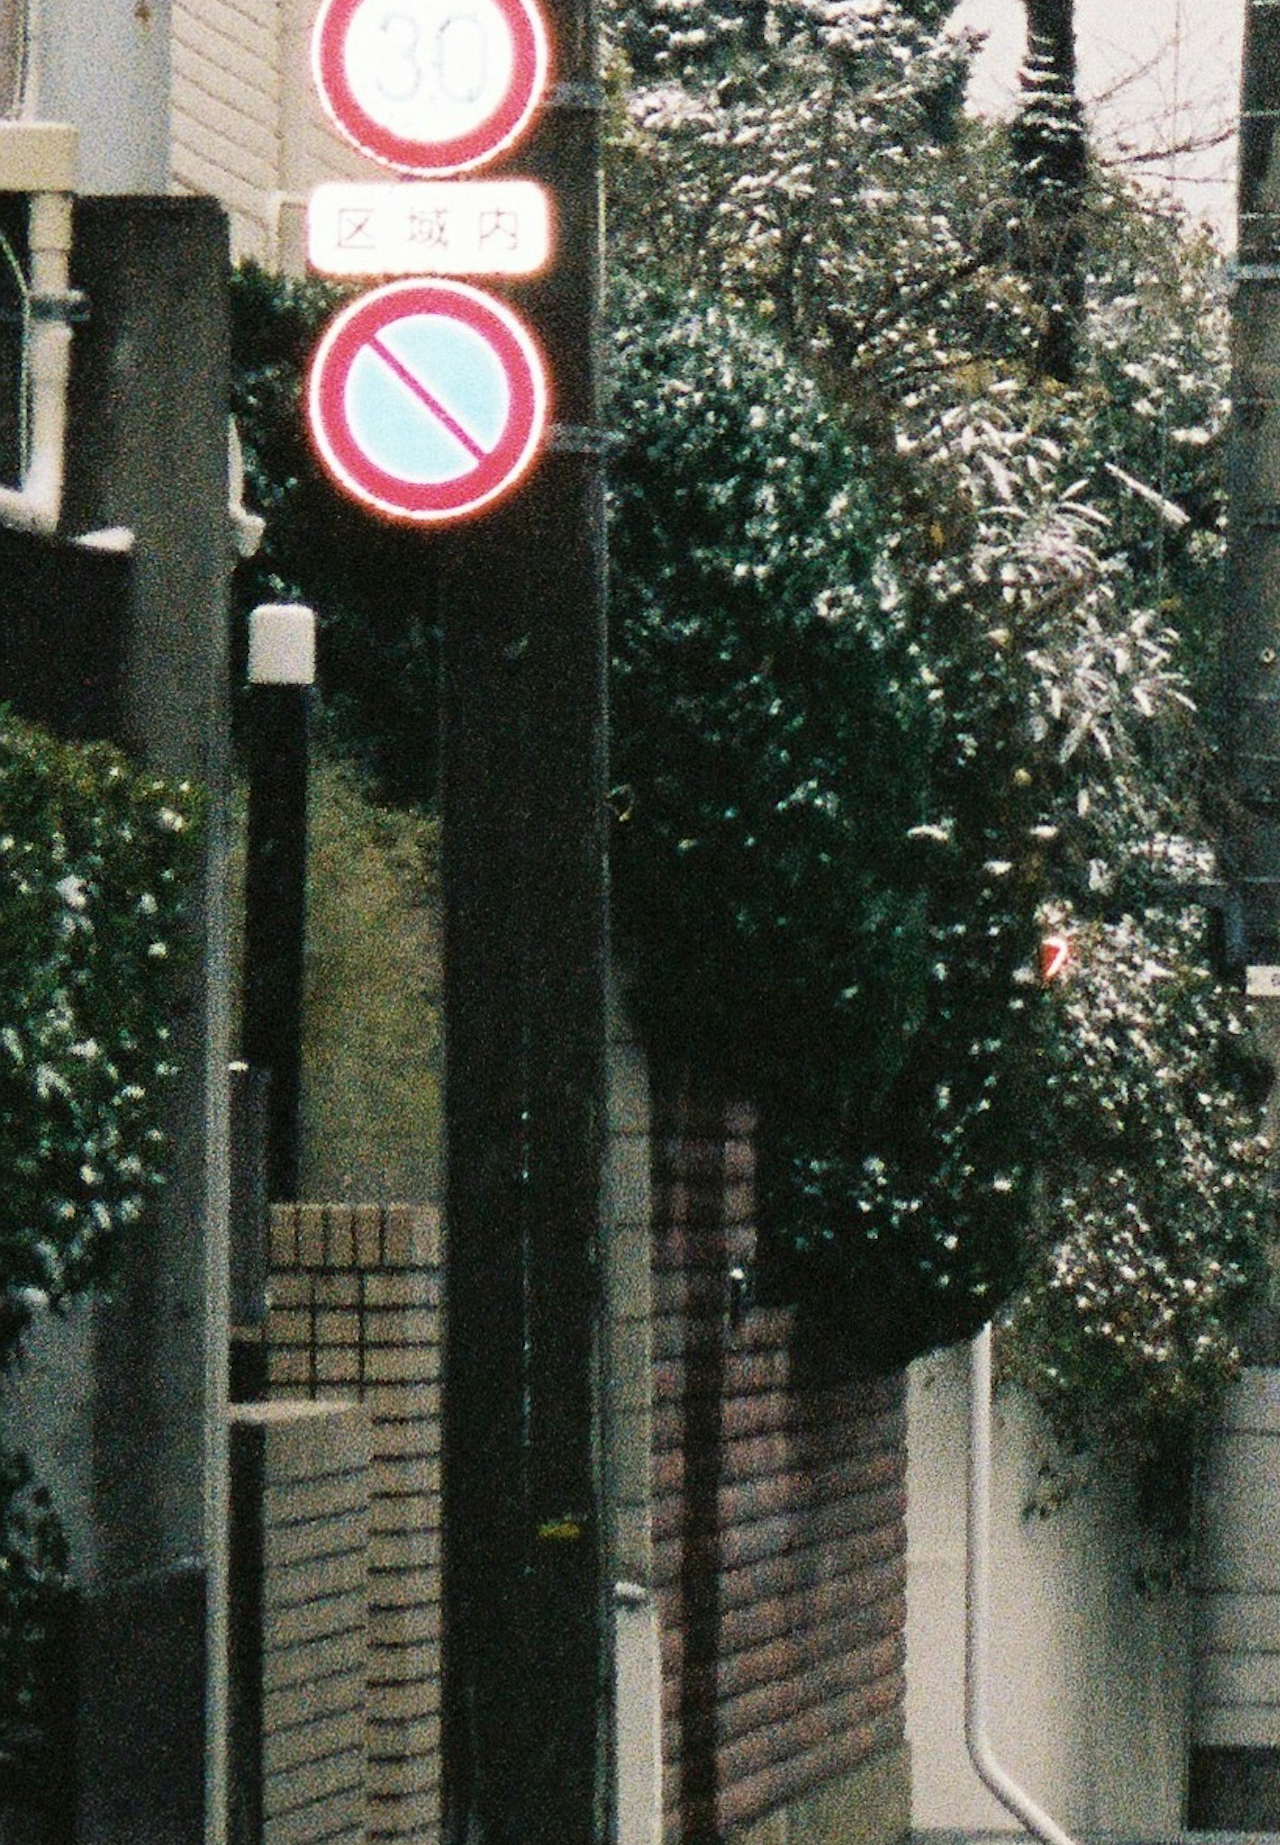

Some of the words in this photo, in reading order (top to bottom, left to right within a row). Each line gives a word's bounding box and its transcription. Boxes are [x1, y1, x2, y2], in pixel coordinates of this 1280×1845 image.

[376, 10, 488, 104] 30
[333, 205, 519, 252] 区域内
